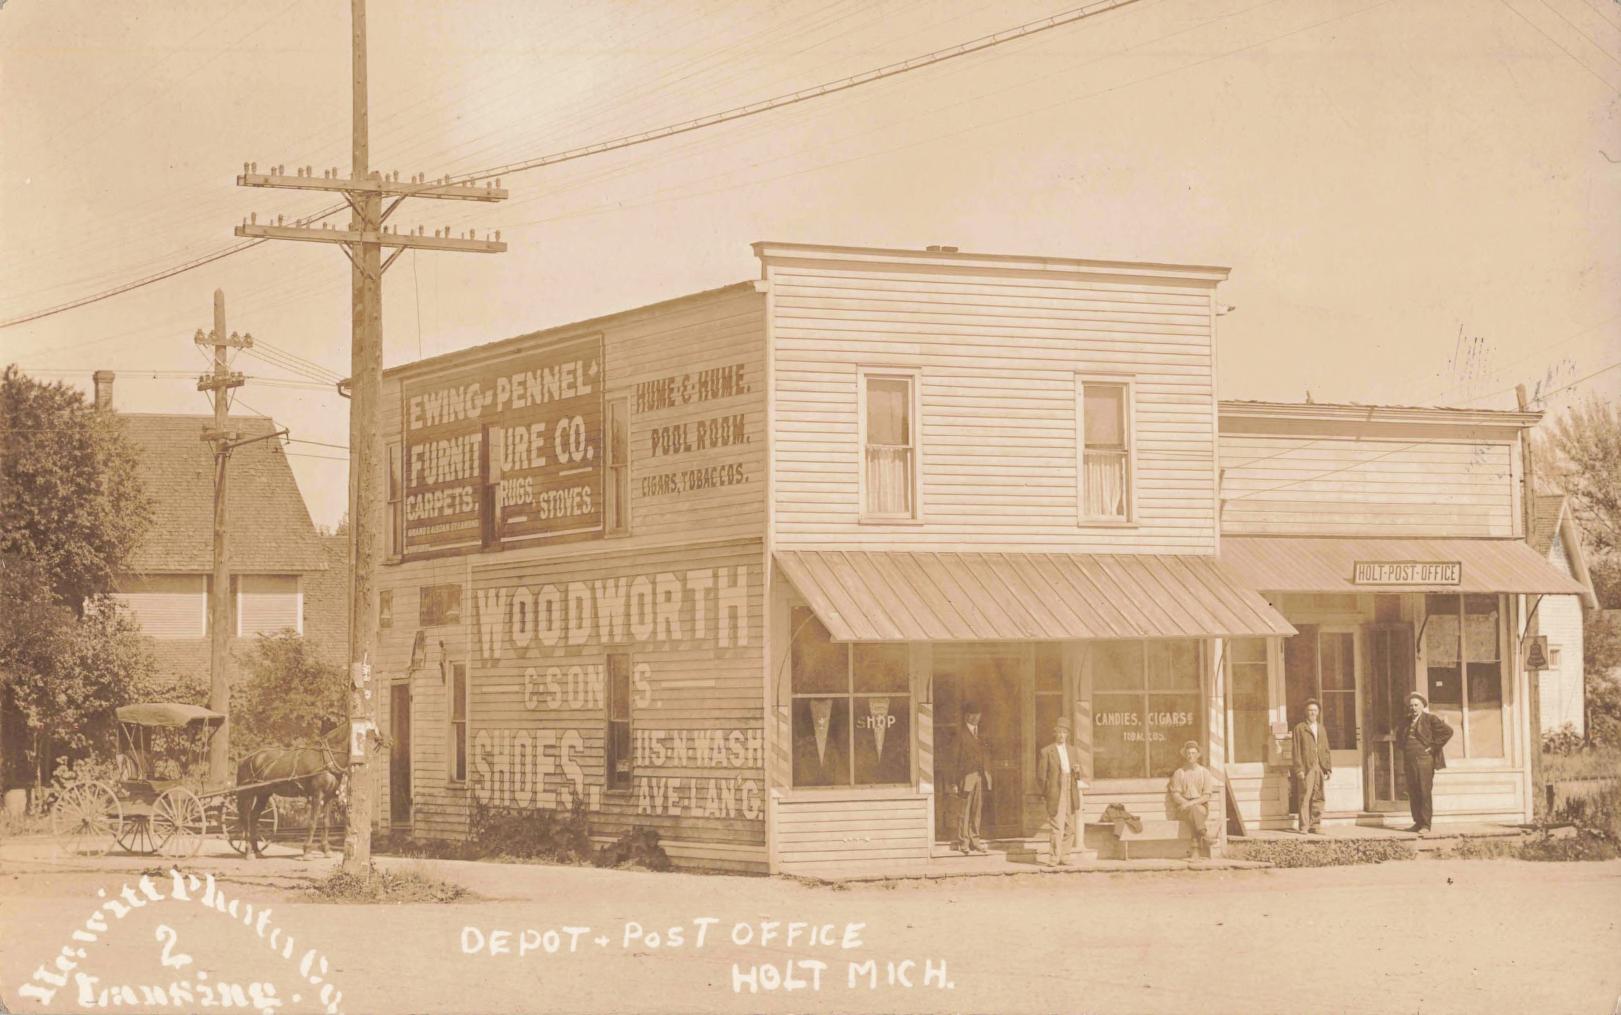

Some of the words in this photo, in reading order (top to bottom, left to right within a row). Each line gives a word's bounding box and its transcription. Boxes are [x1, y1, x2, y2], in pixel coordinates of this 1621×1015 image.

[636, 376, 675, 414] HUME
[554, 415, 594, 464] CO.
[651, 423, 692, 457] POOL
[697, 413, 750, 450] ROOM.
[476, 565, 748, 660] WOODWORTH
